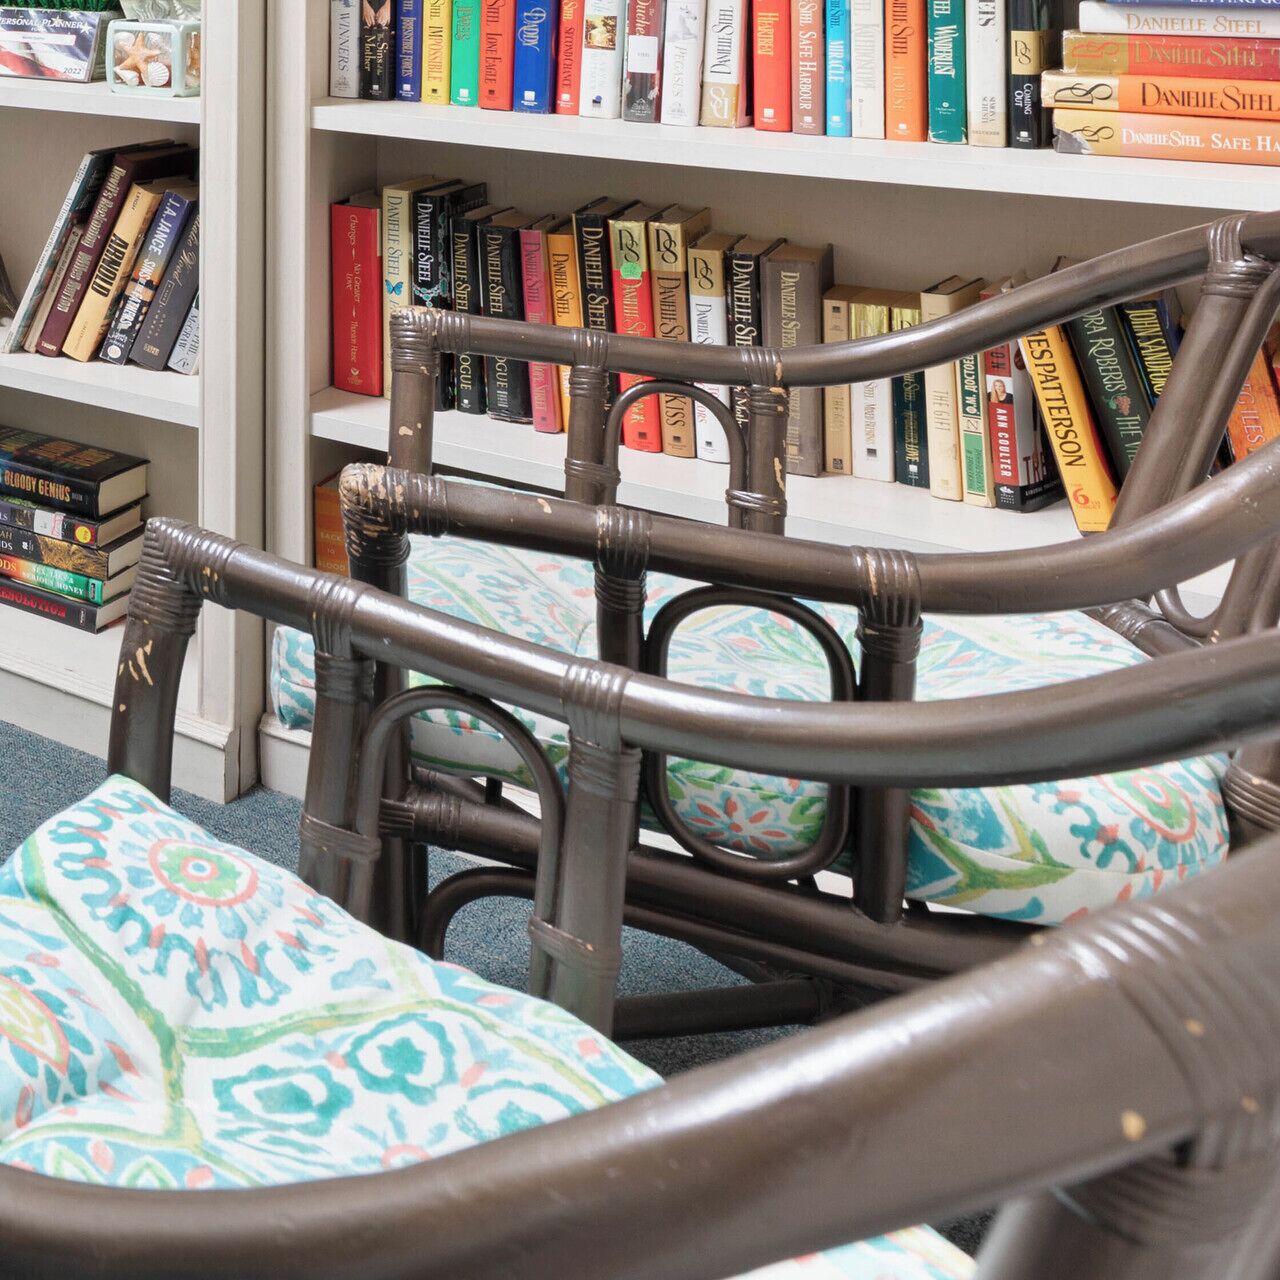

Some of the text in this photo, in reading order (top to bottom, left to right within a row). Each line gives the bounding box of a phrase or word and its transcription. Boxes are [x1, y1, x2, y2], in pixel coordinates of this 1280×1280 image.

[41, 19, 83, 29] PLANNER
[338, 12, 351, 73] WINNERS
[426, 25, 443, 83] IMPOSSIBLE
[798, 26, 815, 111] SAFE HARBOUR
[1014, 90, 1024, 106] OUT
[1023, 83, 1033, 116] COMING
[92, 233, 129, 298] ARNOLD
[996, 407, 1014, 478] ANN COULTER
